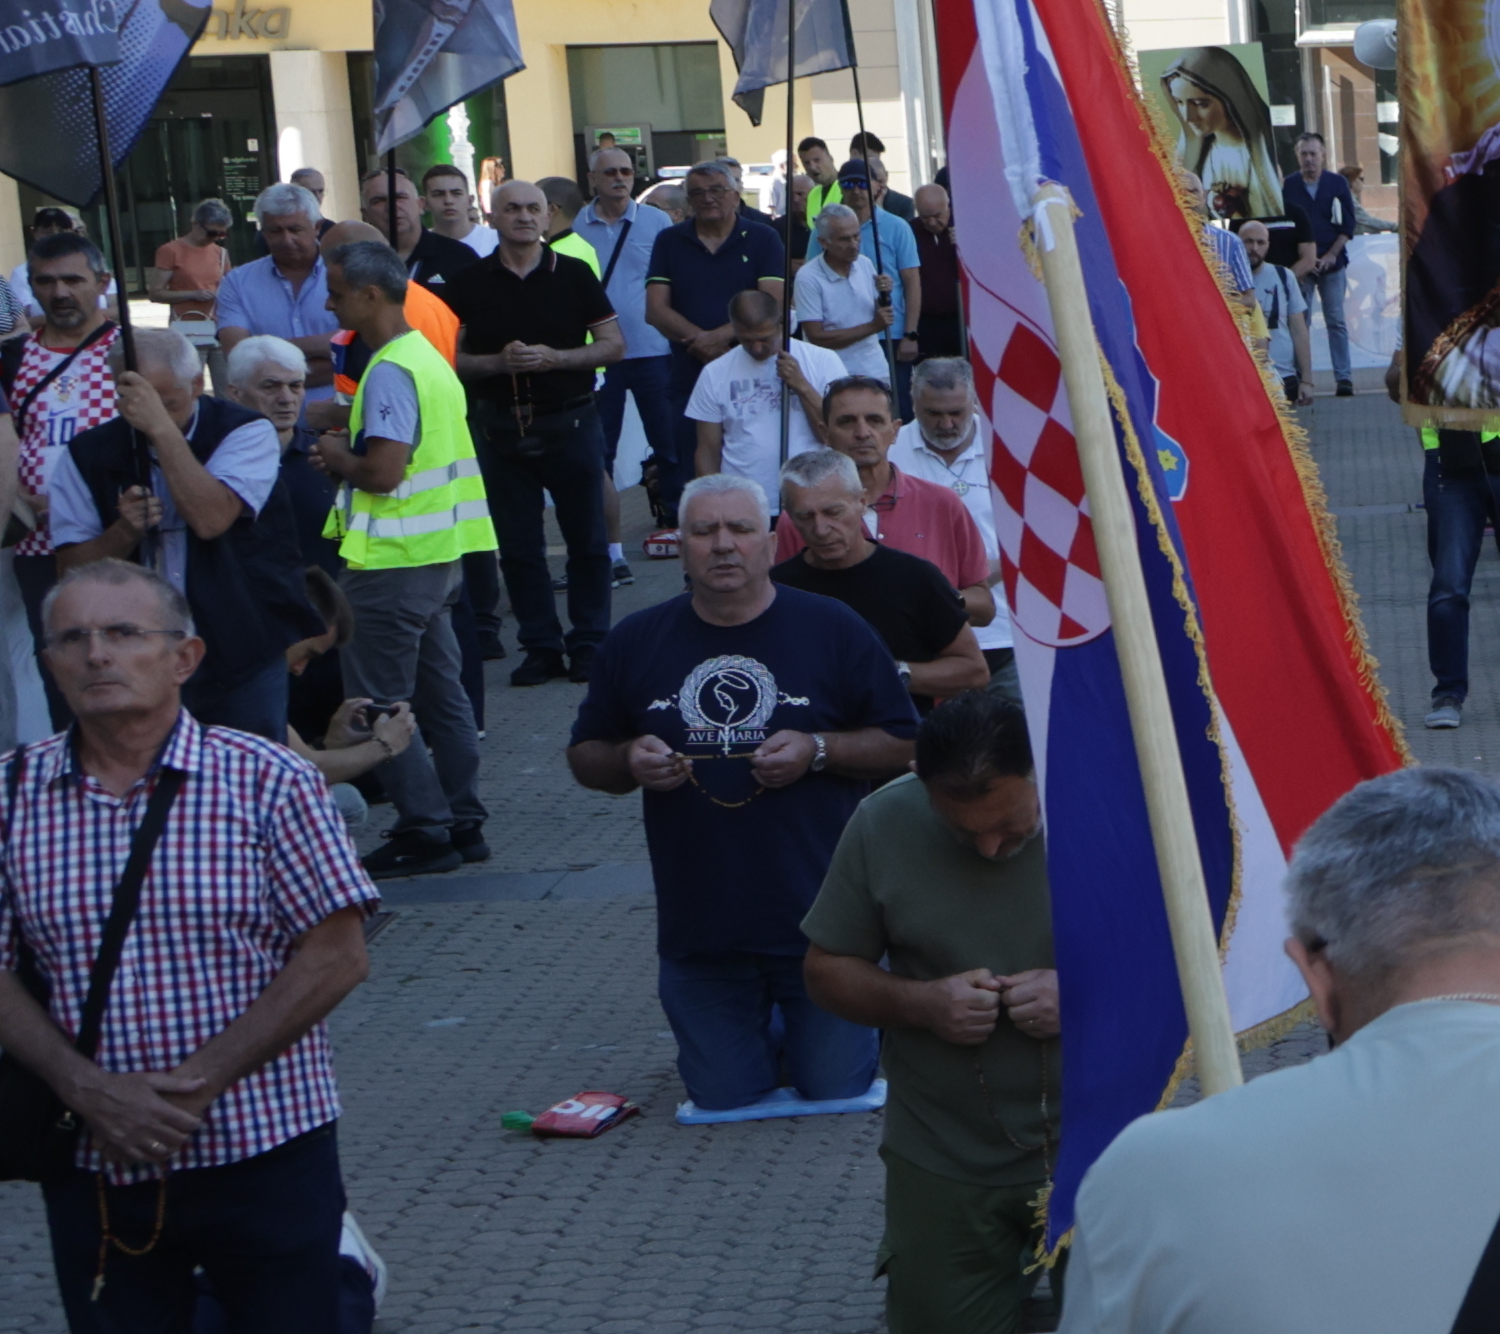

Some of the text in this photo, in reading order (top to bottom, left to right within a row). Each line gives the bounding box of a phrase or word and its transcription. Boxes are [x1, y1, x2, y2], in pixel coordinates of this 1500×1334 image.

[47, 416, 76, 447] 10
[687, 728, 767, 744] AVE MARIA
